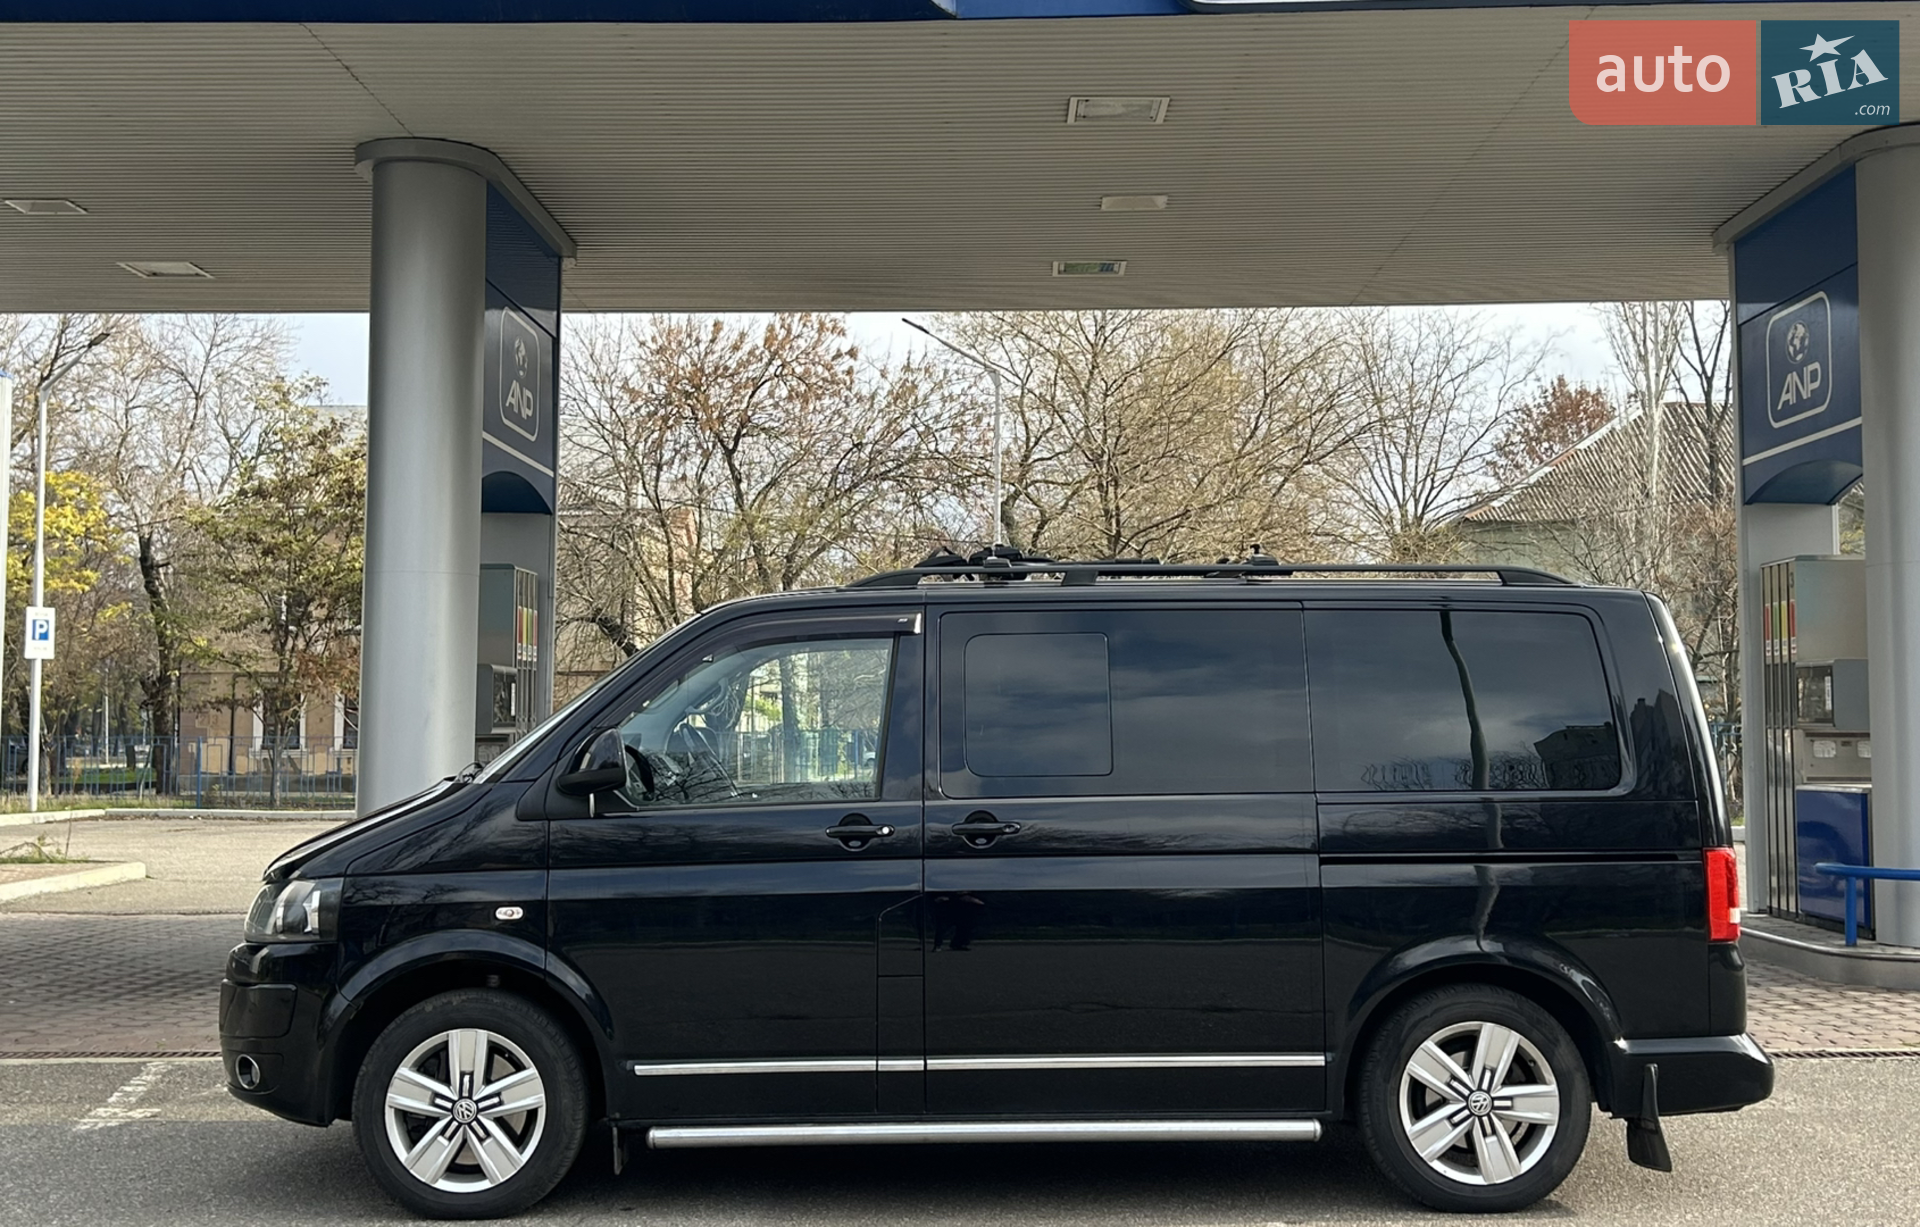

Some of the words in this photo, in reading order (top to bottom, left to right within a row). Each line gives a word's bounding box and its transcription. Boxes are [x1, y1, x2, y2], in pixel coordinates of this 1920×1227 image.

[506, 380, 534, 420] ANP
[1777, 361, 1821, 410] ANP
[34, 620, 48, 640] P
